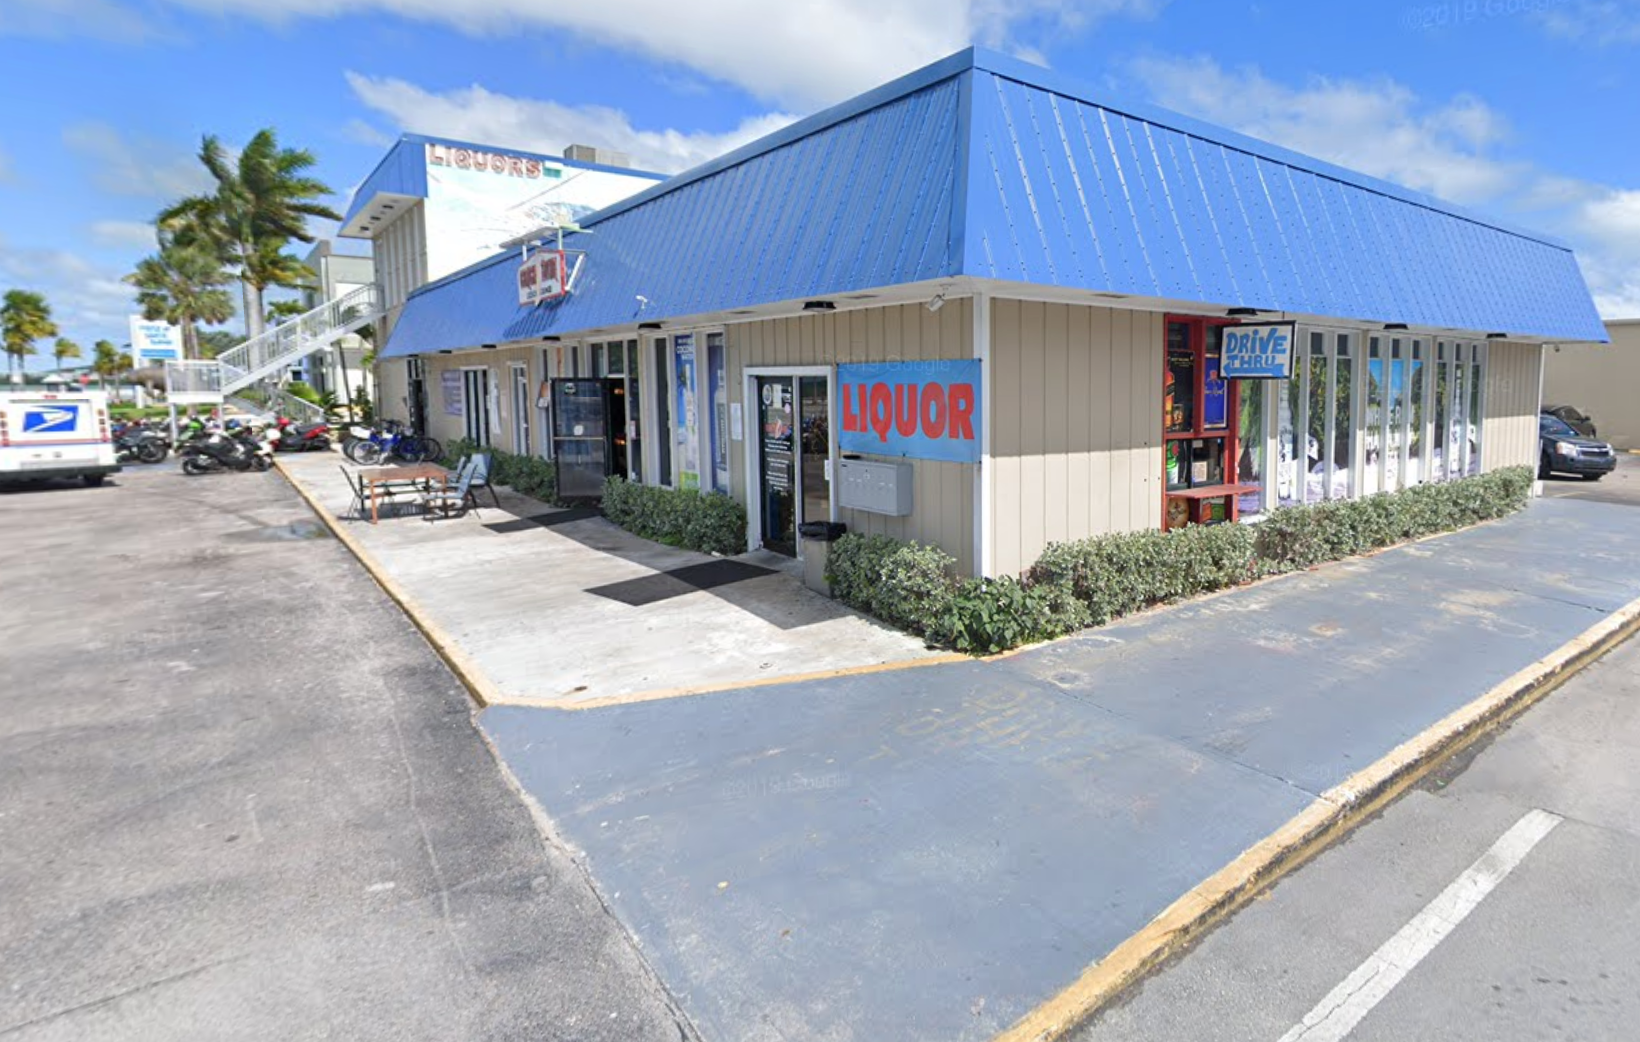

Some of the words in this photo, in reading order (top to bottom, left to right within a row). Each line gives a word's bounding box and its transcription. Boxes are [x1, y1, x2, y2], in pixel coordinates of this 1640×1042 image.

[429, 142, 541, 179] LIQUORS
[1226, 355, 1277, 368] THRU
[842, 381, 975, 443] LIQUOR
